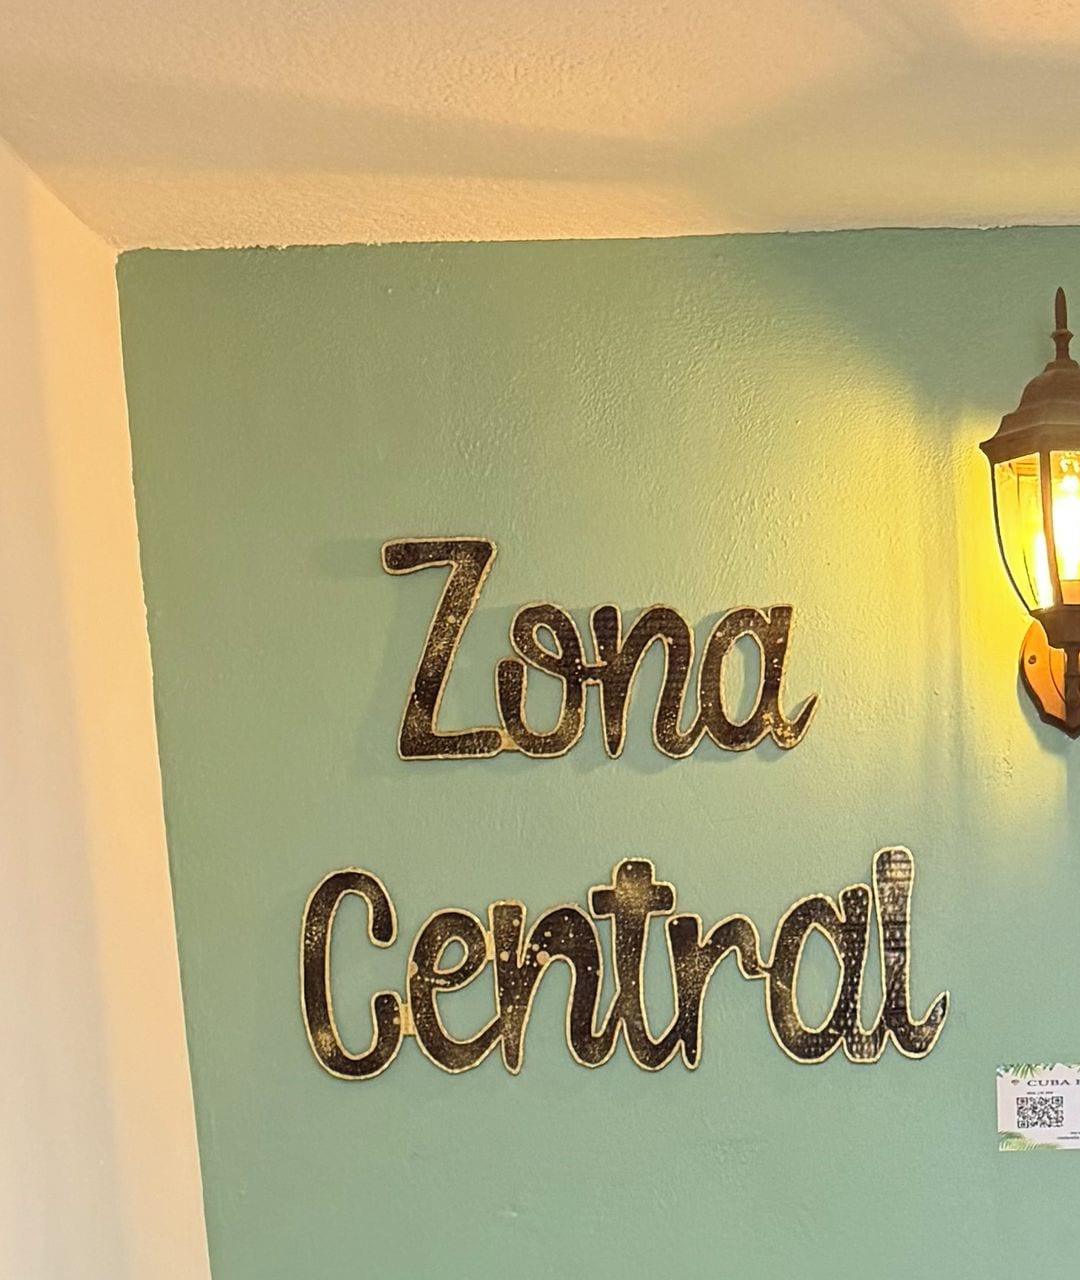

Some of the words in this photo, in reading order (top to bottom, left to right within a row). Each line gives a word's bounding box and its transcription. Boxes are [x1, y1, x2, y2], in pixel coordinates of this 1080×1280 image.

[381, 536, 819, 761] Zona
[302, 845, 950, 1080] Central
[1026, 1079, 1070, 1087] CUBA
